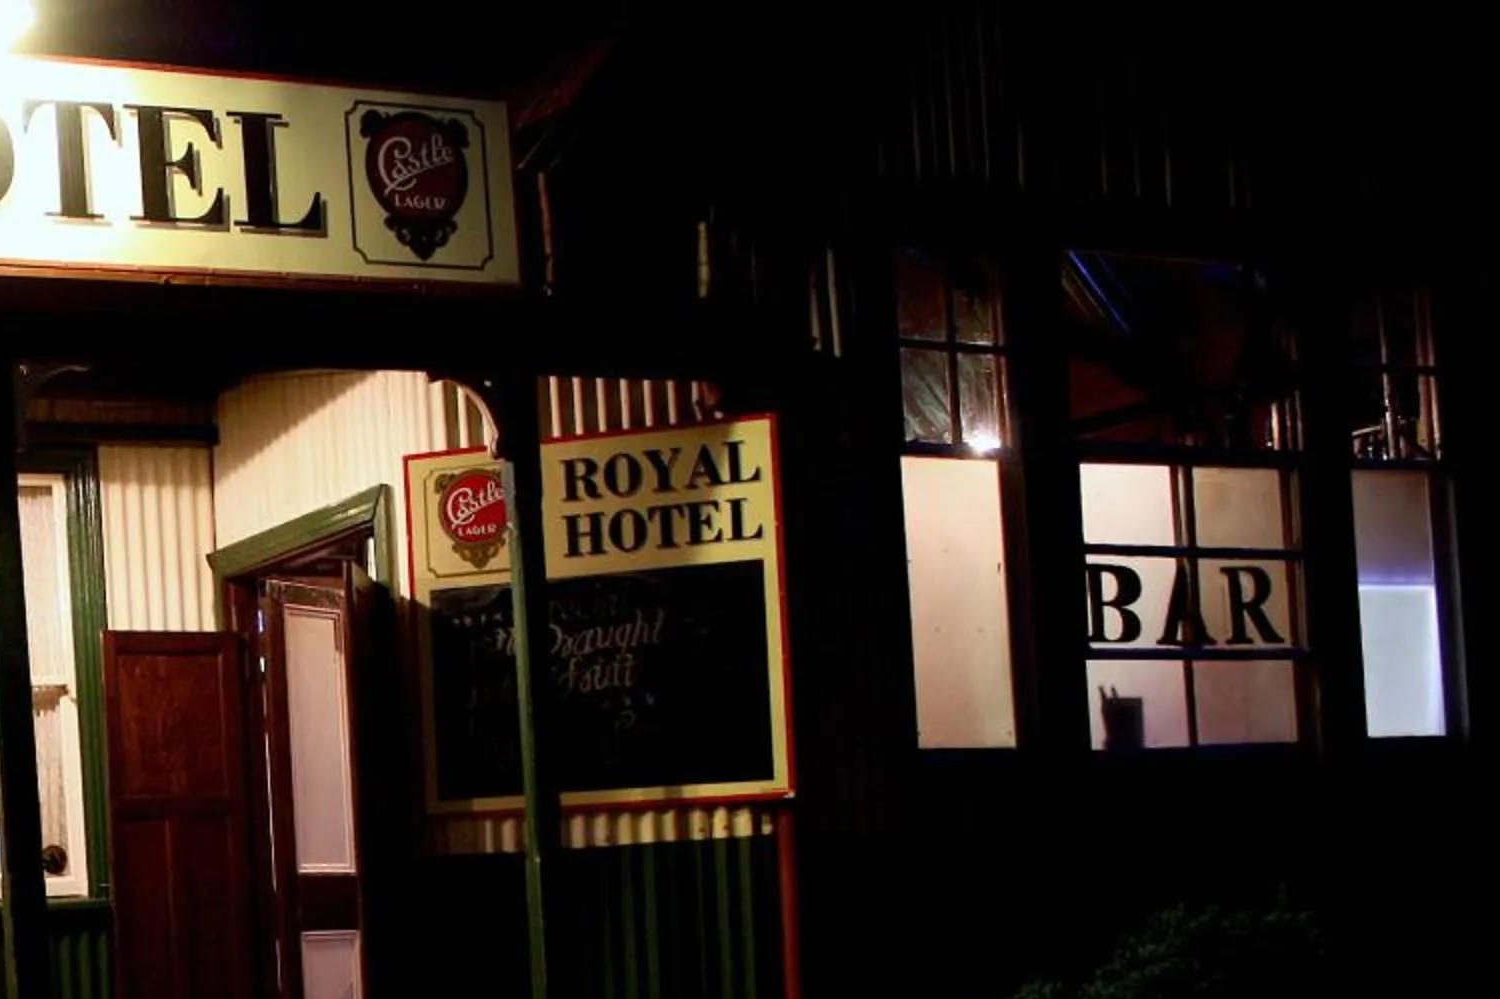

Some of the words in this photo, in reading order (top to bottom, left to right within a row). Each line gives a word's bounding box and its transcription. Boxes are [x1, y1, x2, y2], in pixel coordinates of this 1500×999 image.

[378, 132, 455, 197] Castle
[394, 193, 447, 210] LAGER
[561, 439, 761, 502] ROYAL
[456, 522, 498, 537] LAGER
[562, 498, 764, 559] HOTEL
[1085, 562, 1286, 646] BAR
